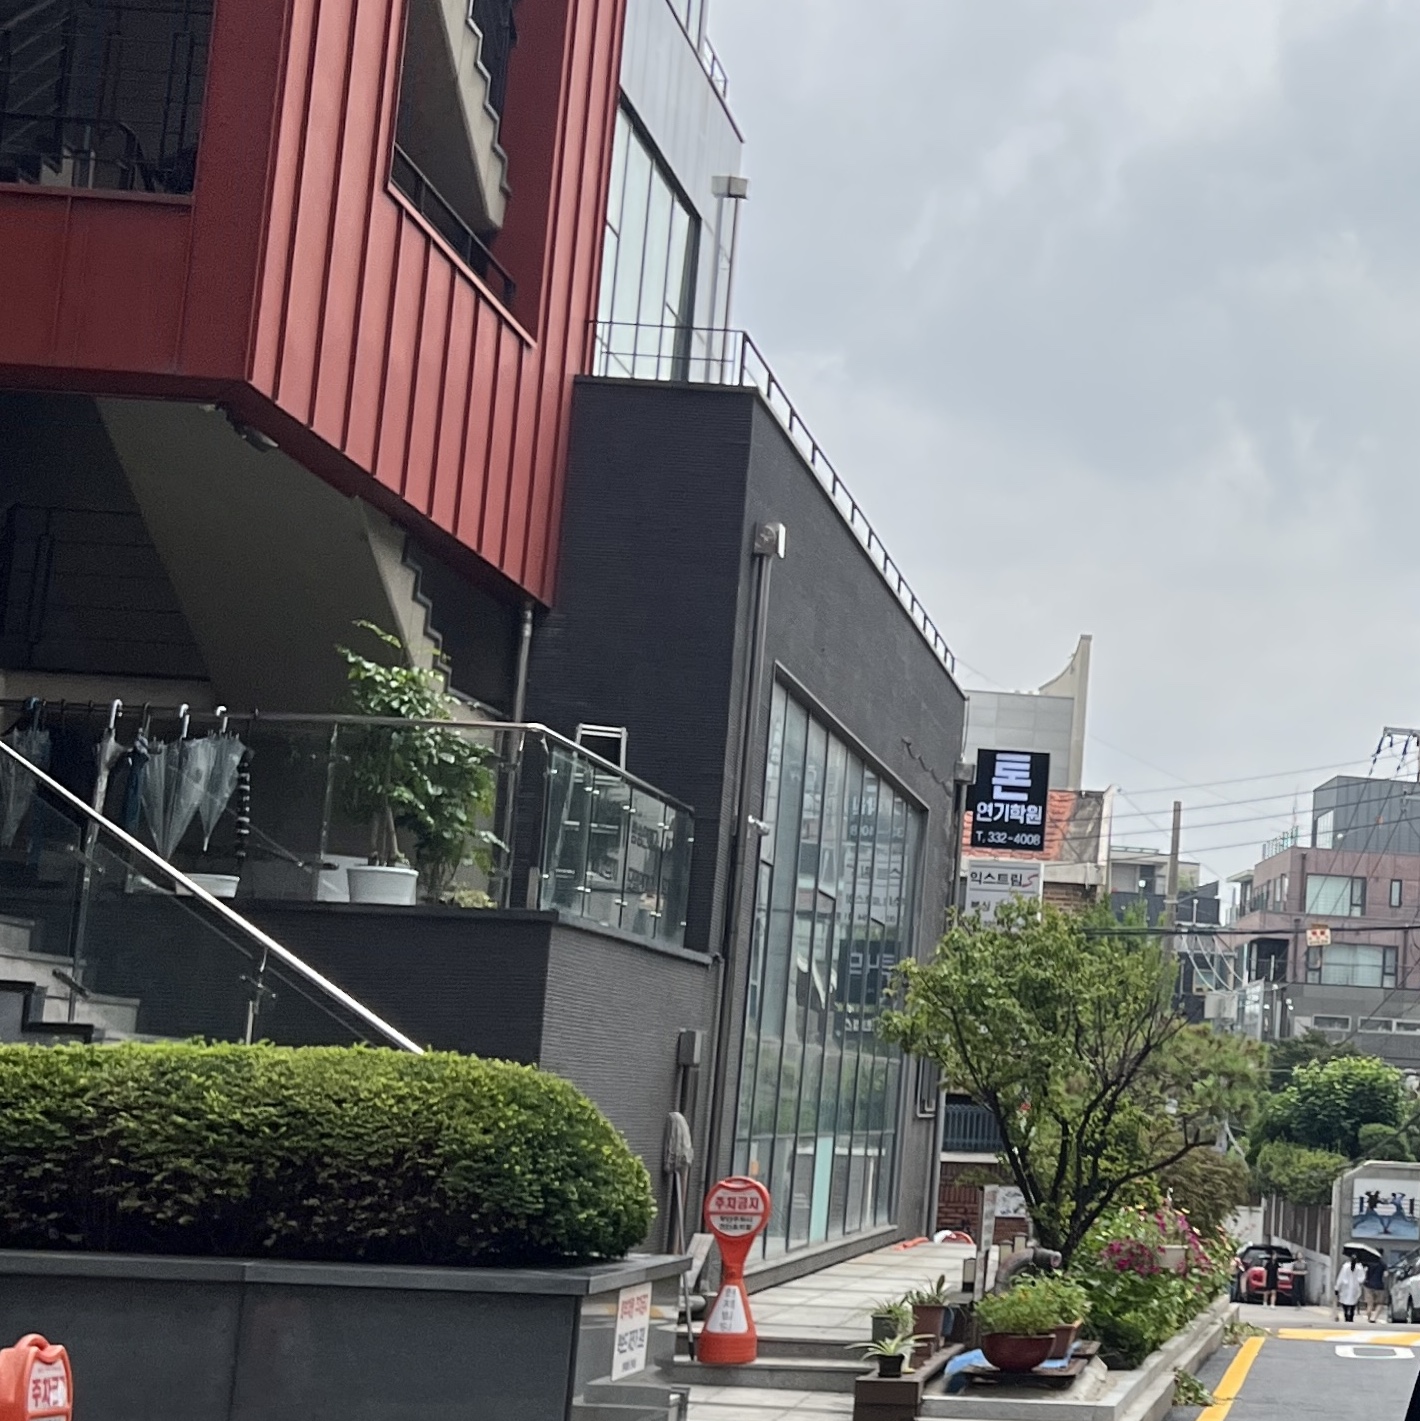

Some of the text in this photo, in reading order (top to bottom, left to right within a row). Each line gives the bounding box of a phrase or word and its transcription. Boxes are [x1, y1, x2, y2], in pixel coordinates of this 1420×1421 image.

[976, 801, 1042, 825] 연기학원
[987, 831, 1041, 846] 332-4008
[970, 871, 1023, 887] 익스트림
[715, 1196, 759, 1210] 주차금지
